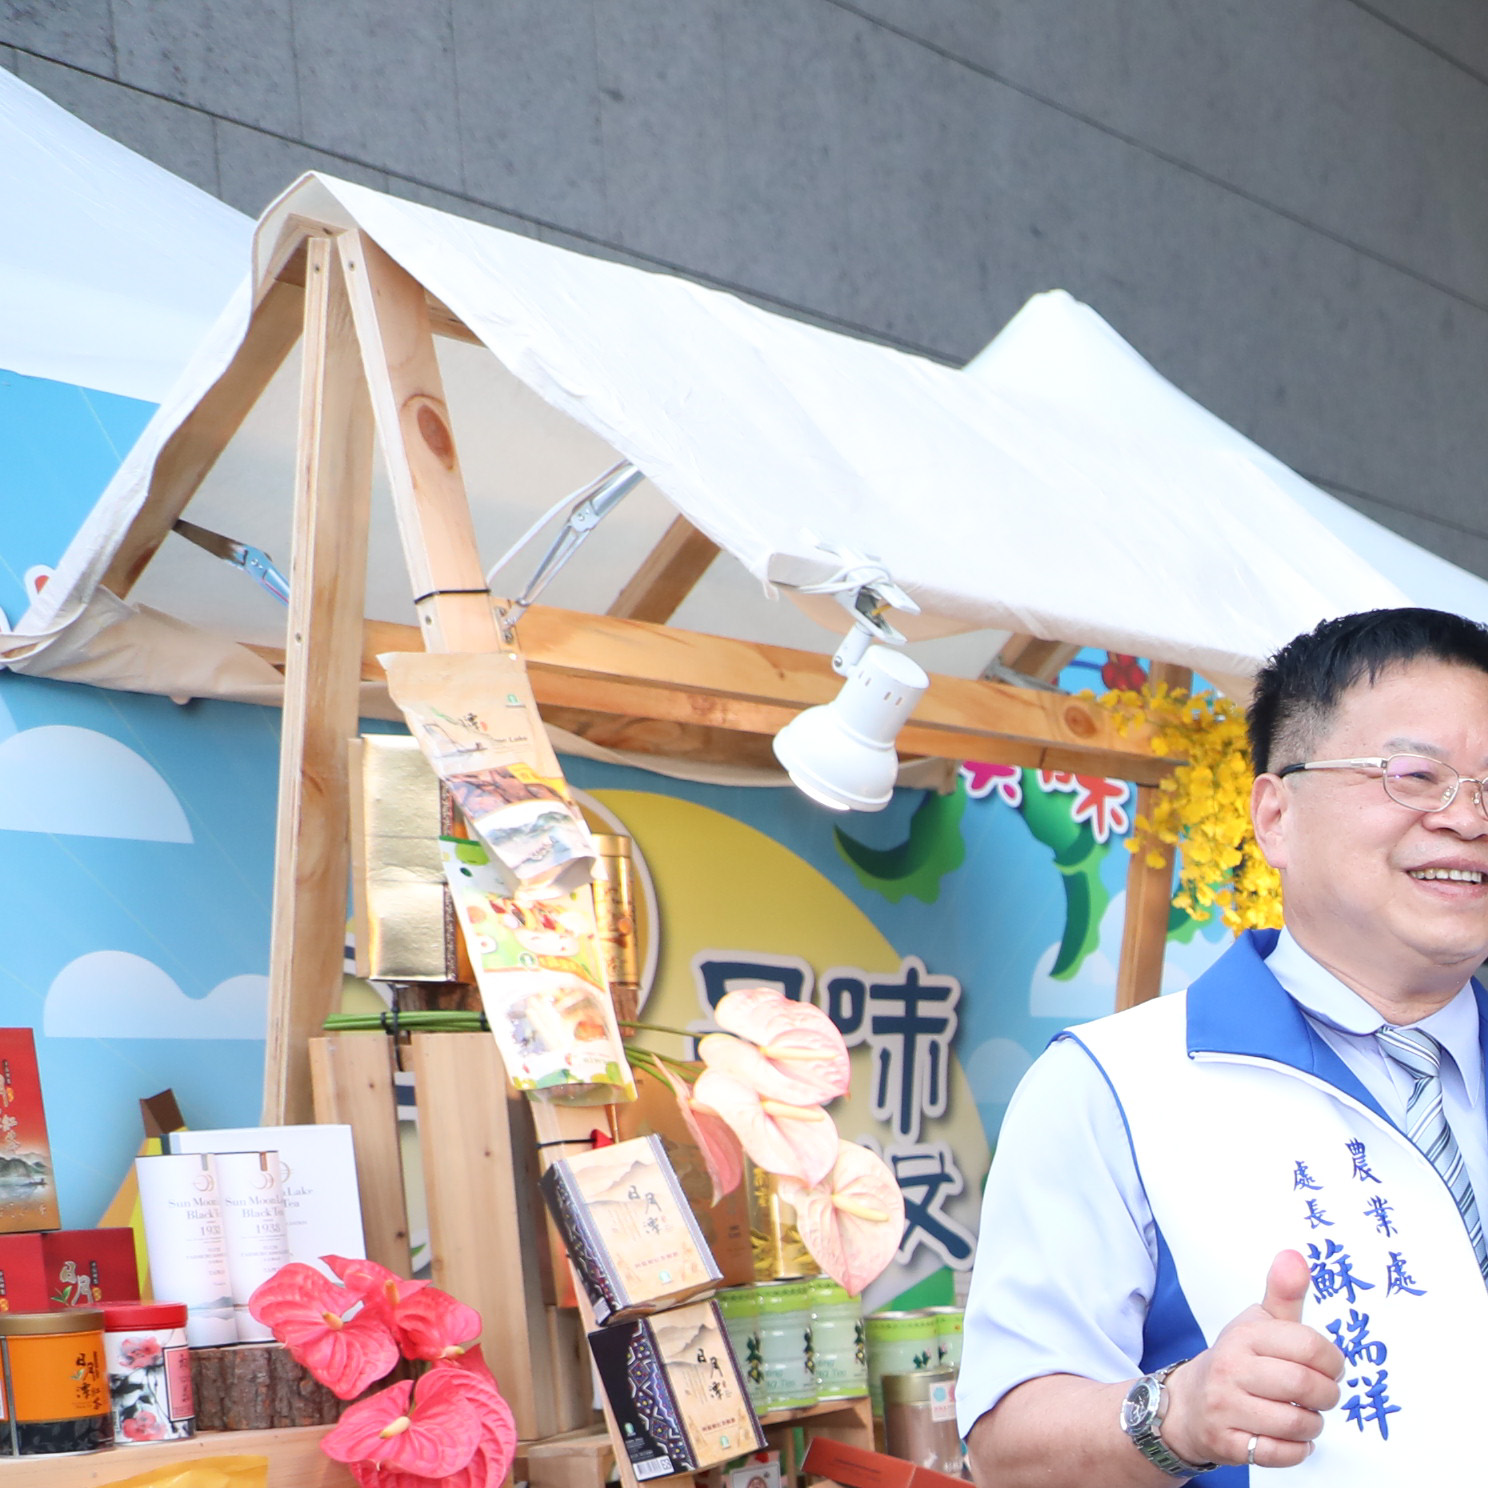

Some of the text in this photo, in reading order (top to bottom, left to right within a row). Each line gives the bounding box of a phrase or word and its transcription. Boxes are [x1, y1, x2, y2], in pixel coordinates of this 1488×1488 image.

[1293, 1160, 1336, 1231] 處長
[1344, 1138, 1428, 1299] 農業處
[697, 1348, 723, 1400] 日月潭
[1305, 1238, 1402, 1442] 蘇瑞祥
